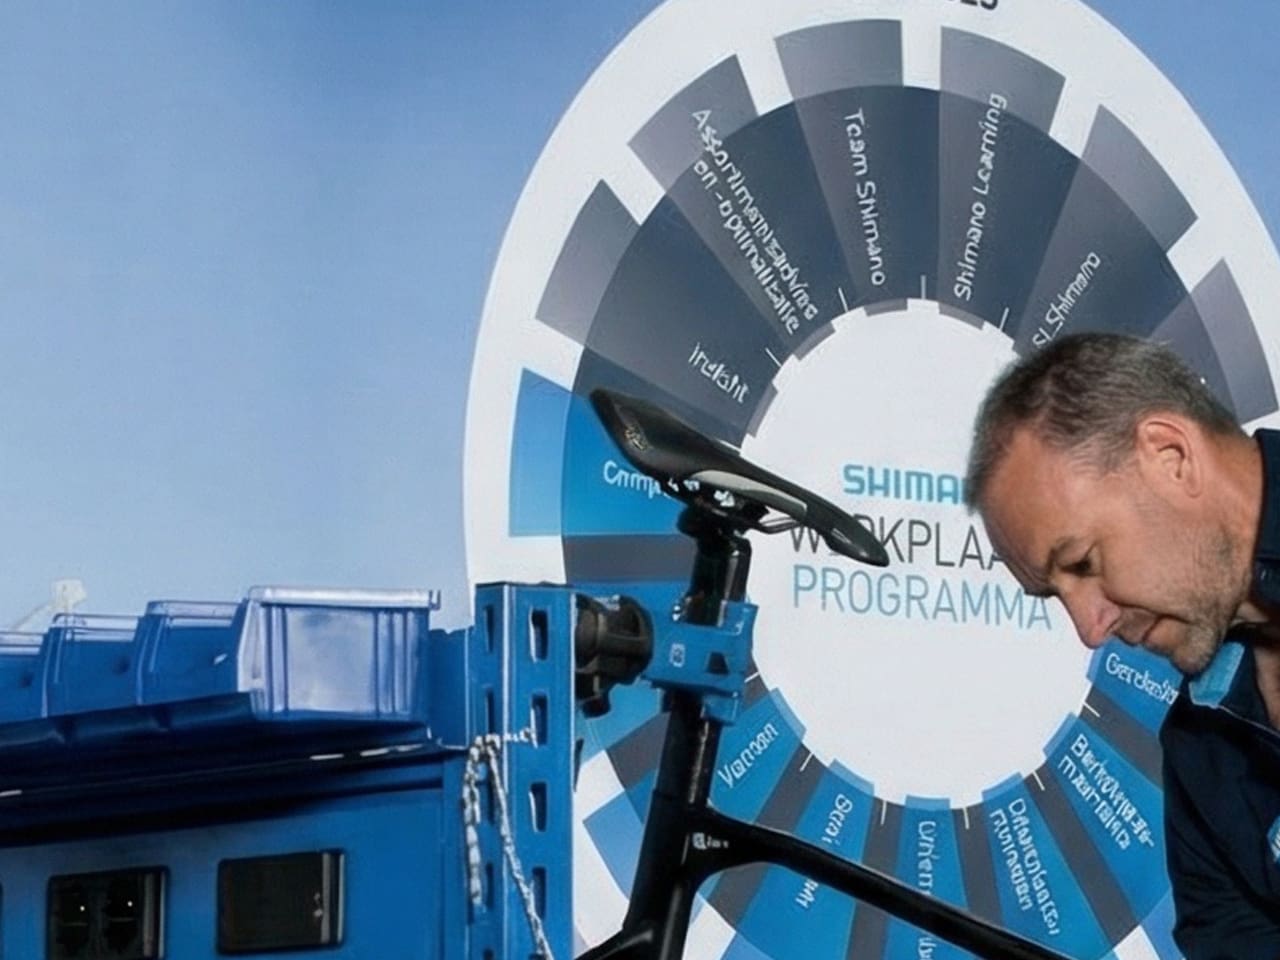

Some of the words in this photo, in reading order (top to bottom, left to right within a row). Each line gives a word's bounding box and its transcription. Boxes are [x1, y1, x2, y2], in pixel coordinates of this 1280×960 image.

[843, 107, 868, 177] Team
[856, 180, 886, 286] Shimano
[953, 201, 987, 301] Shimano
[972, 93, 1008, 195] Learning
[842, 464, 968, 505] SHIMA
[793, 564, 1052, 631] PROGRAMMA
